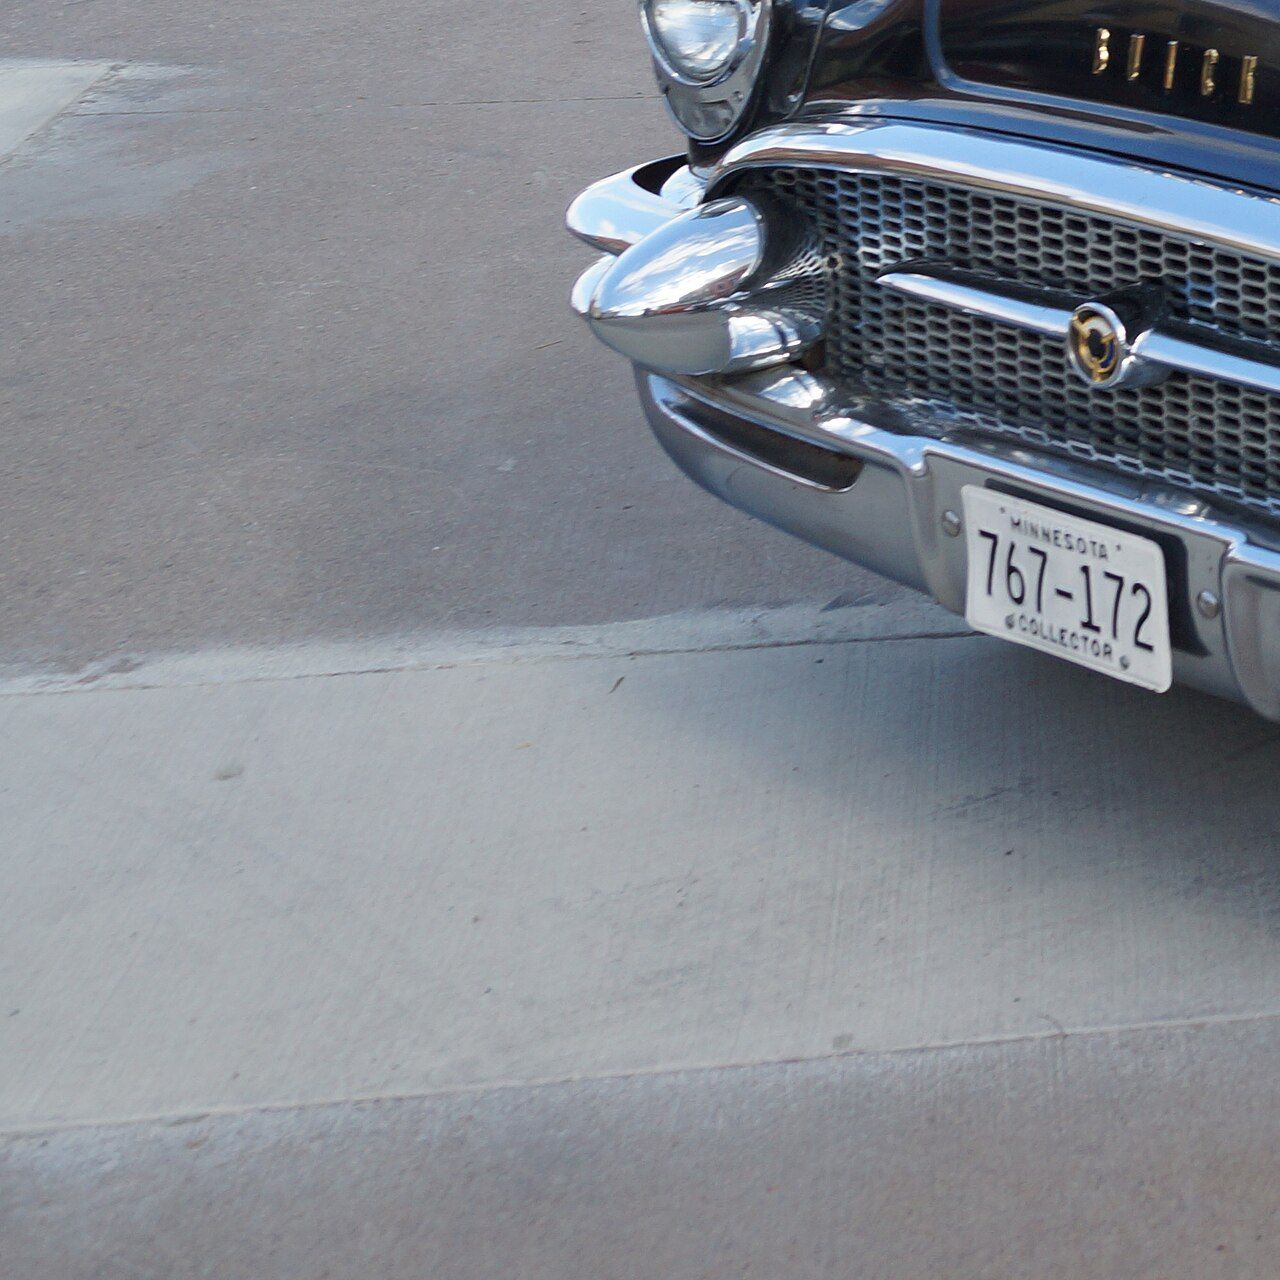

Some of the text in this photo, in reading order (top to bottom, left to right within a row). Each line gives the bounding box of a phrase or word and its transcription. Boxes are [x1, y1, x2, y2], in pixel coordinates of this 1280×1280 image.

[1092, 28, 1259, 105] BUICK
[1010, 516, 1109, 560] MINNESOTA
[978, 529, 1154, 652] 767-172
[1018, 614, 1113, 659] COLLECTOR
